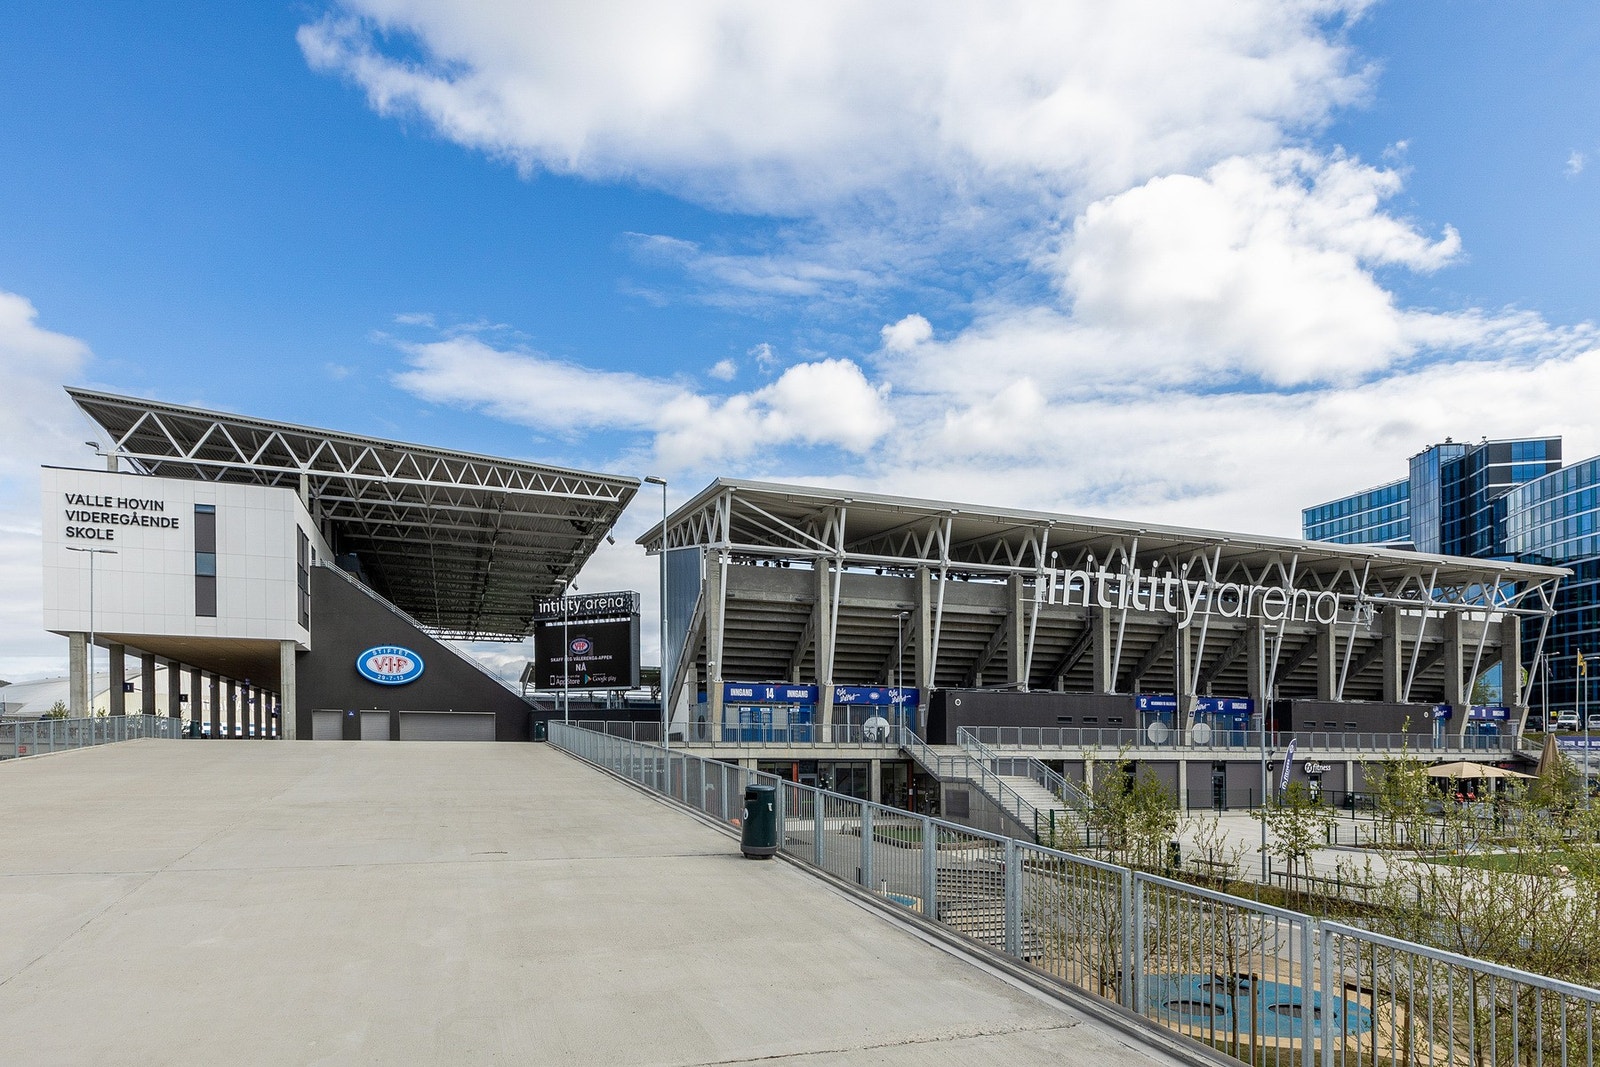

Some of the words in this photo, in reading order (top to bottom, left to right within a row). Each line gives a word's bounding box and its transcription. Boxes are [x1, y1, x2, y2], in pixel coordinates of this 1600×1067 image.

[65, 493, 113, 508] VALLE
[117, 497, 164, 512] HOVIN
[65, 509, 179, 529] VIDEREGÅENDE
[65, 526, 114, 540] SKOLE
[1047, 550, 1205, 630] intility
[1217, 582, 1341, 625] arena
[538, 597, 581, 614] intilty
[585, 597, 624, 609] arena
[372, 648, 409, 656] STIFTET
[575, 662, 587, 671] NÅ
[765, 687, 775, 699] 14
[1140, 698, 1147, 708] 12
[1217, 701, 1224, 710] 12
[1311, 763, 1331, 774] fitness
